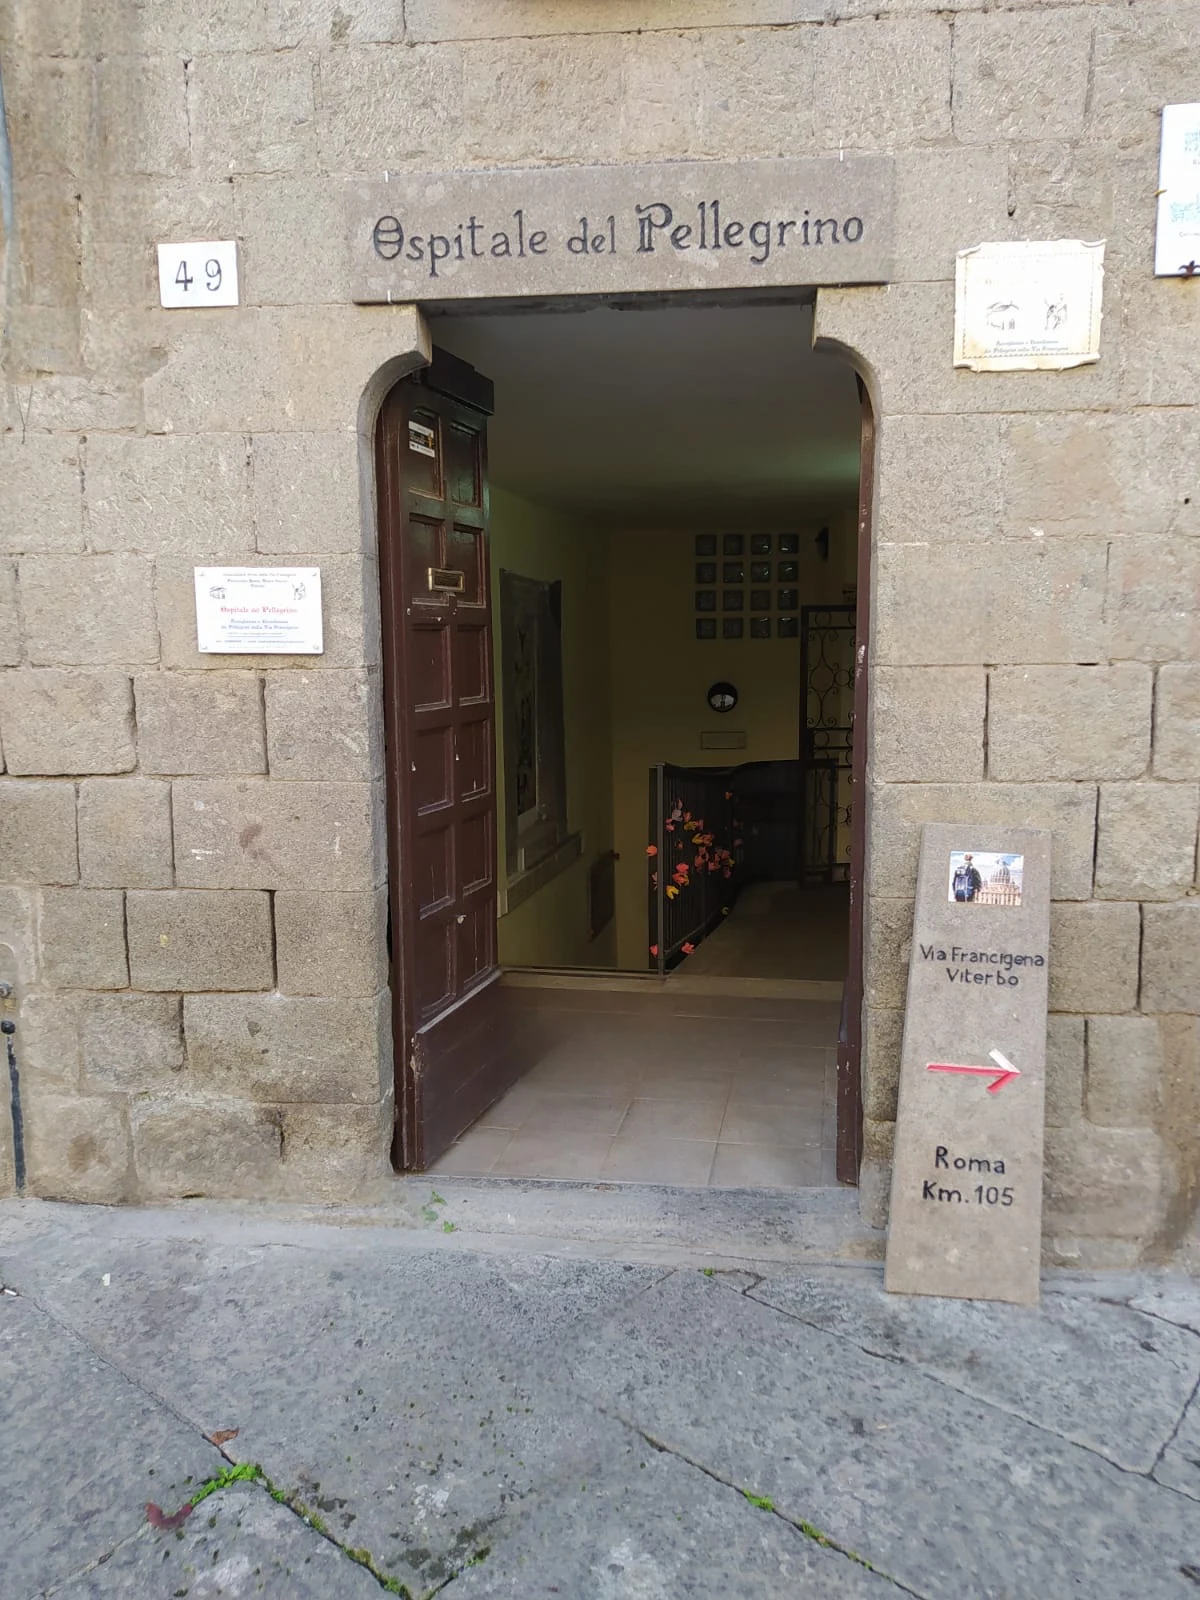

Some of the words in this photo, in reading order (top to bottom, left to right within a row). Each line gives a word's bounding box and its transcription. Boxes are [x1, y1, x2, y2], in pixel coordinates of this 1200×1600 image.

[372, 209, 549, 278] Ospitale
[566, 214, 617, 255] del
[634, 199, 864, 265] Pellegrino
[175, 258, 222, 292] 49
[920, 944, 947, 961] Via
[951, 946, 1045, 971] Francigena
[946, 967, 1019, 986] Viterbo
[935, 1145, 1006, 1175] Roma
